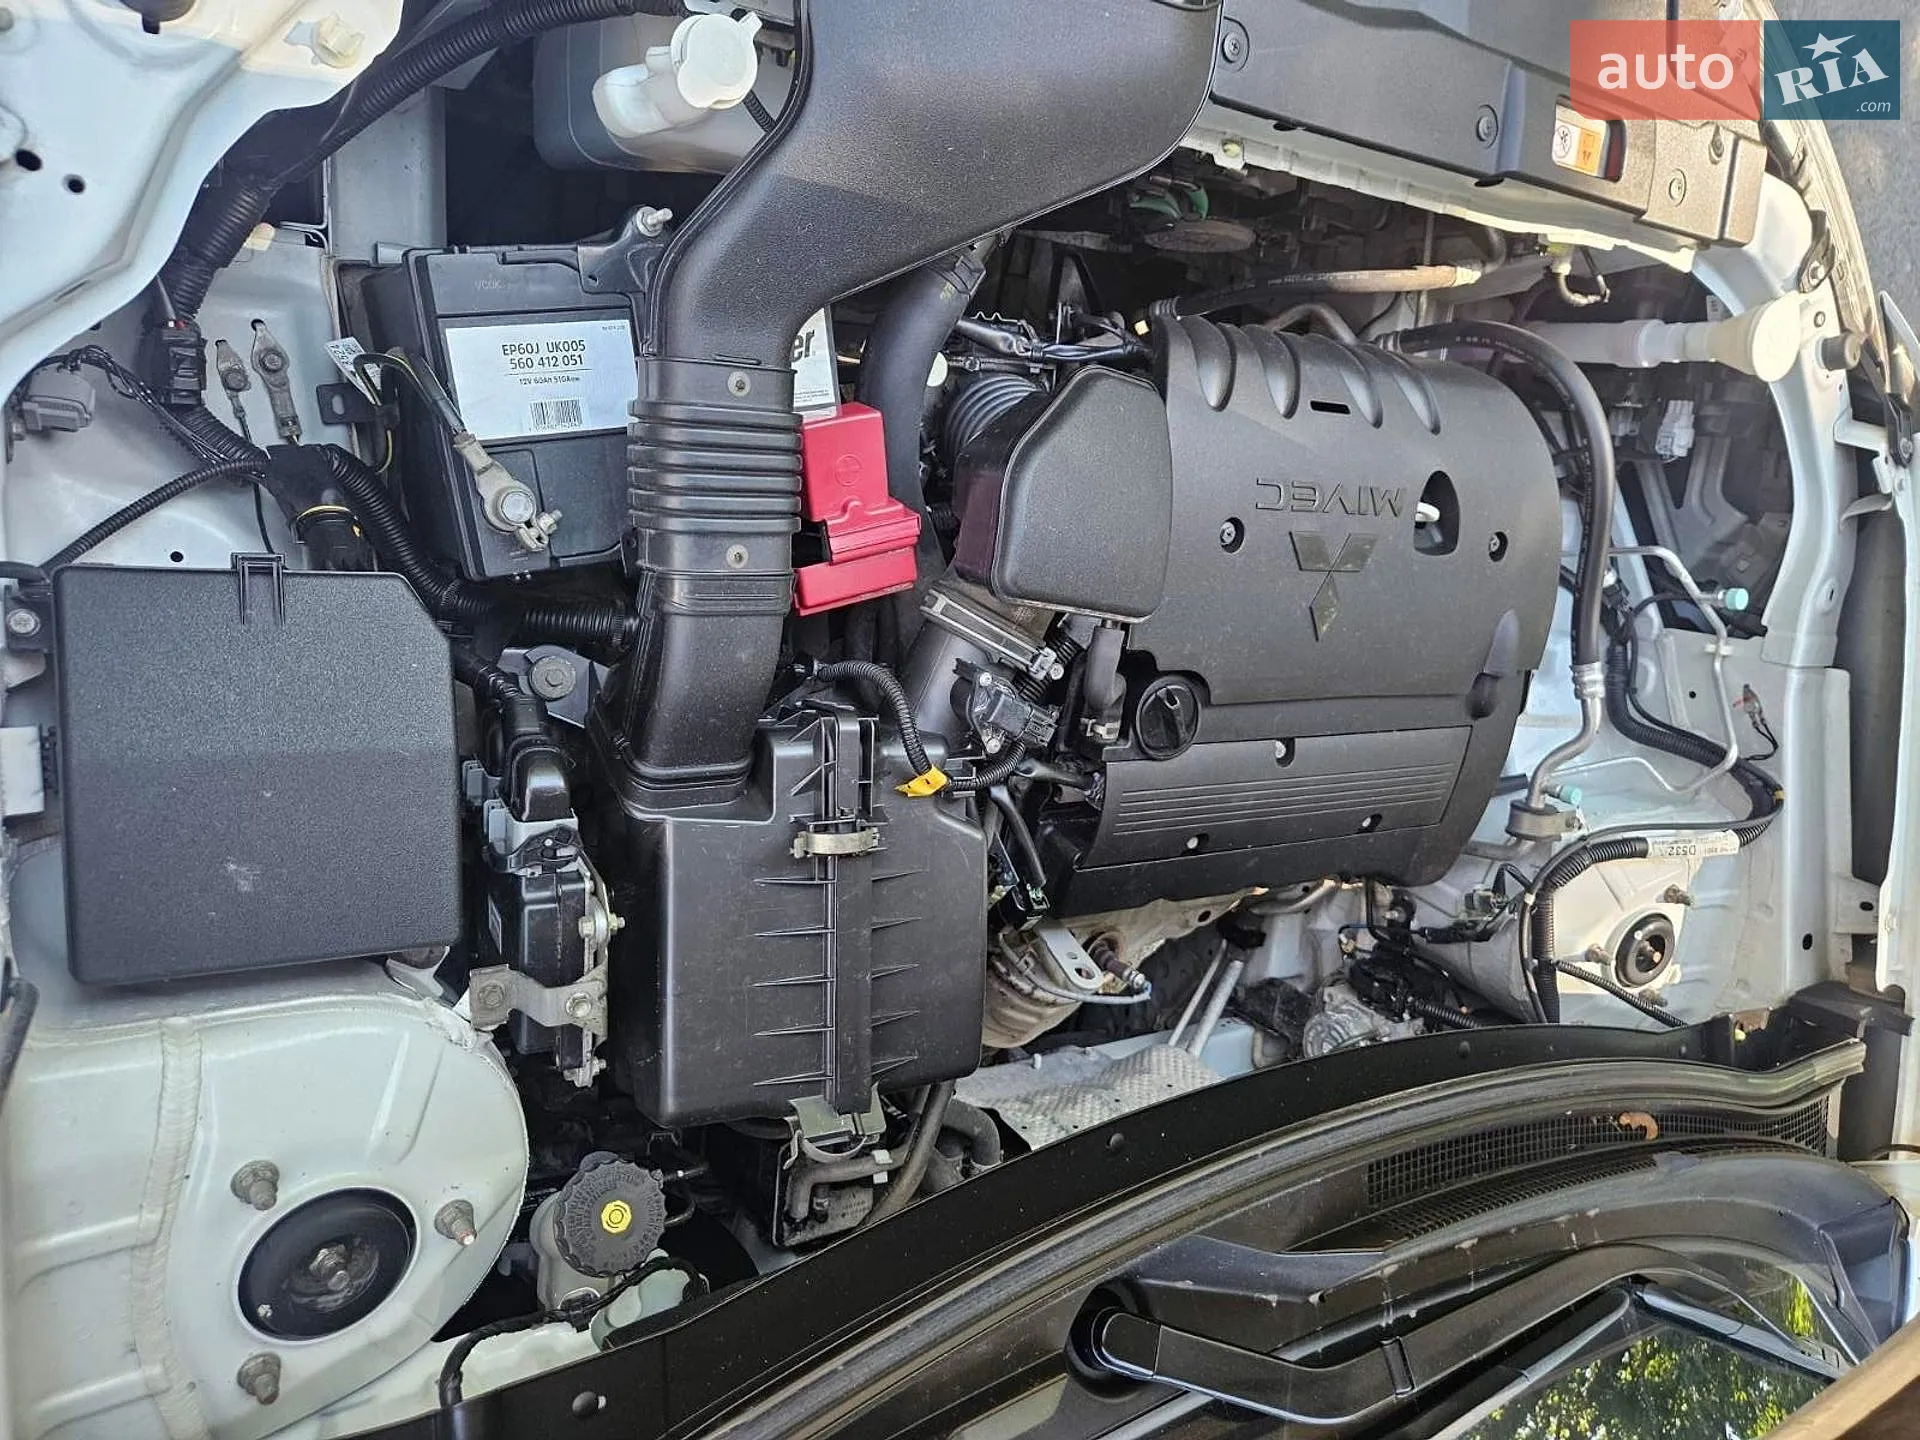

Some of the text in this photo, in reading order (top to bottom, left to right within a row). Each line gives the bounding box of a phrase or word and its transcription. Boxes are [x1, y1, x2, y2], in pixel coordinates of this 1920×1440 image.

[502, 339, 586, 356] EP60J UK005
[510, 354, 584, 369] 560 412 051
[1256, 477, 1406, 517] MIVEC
